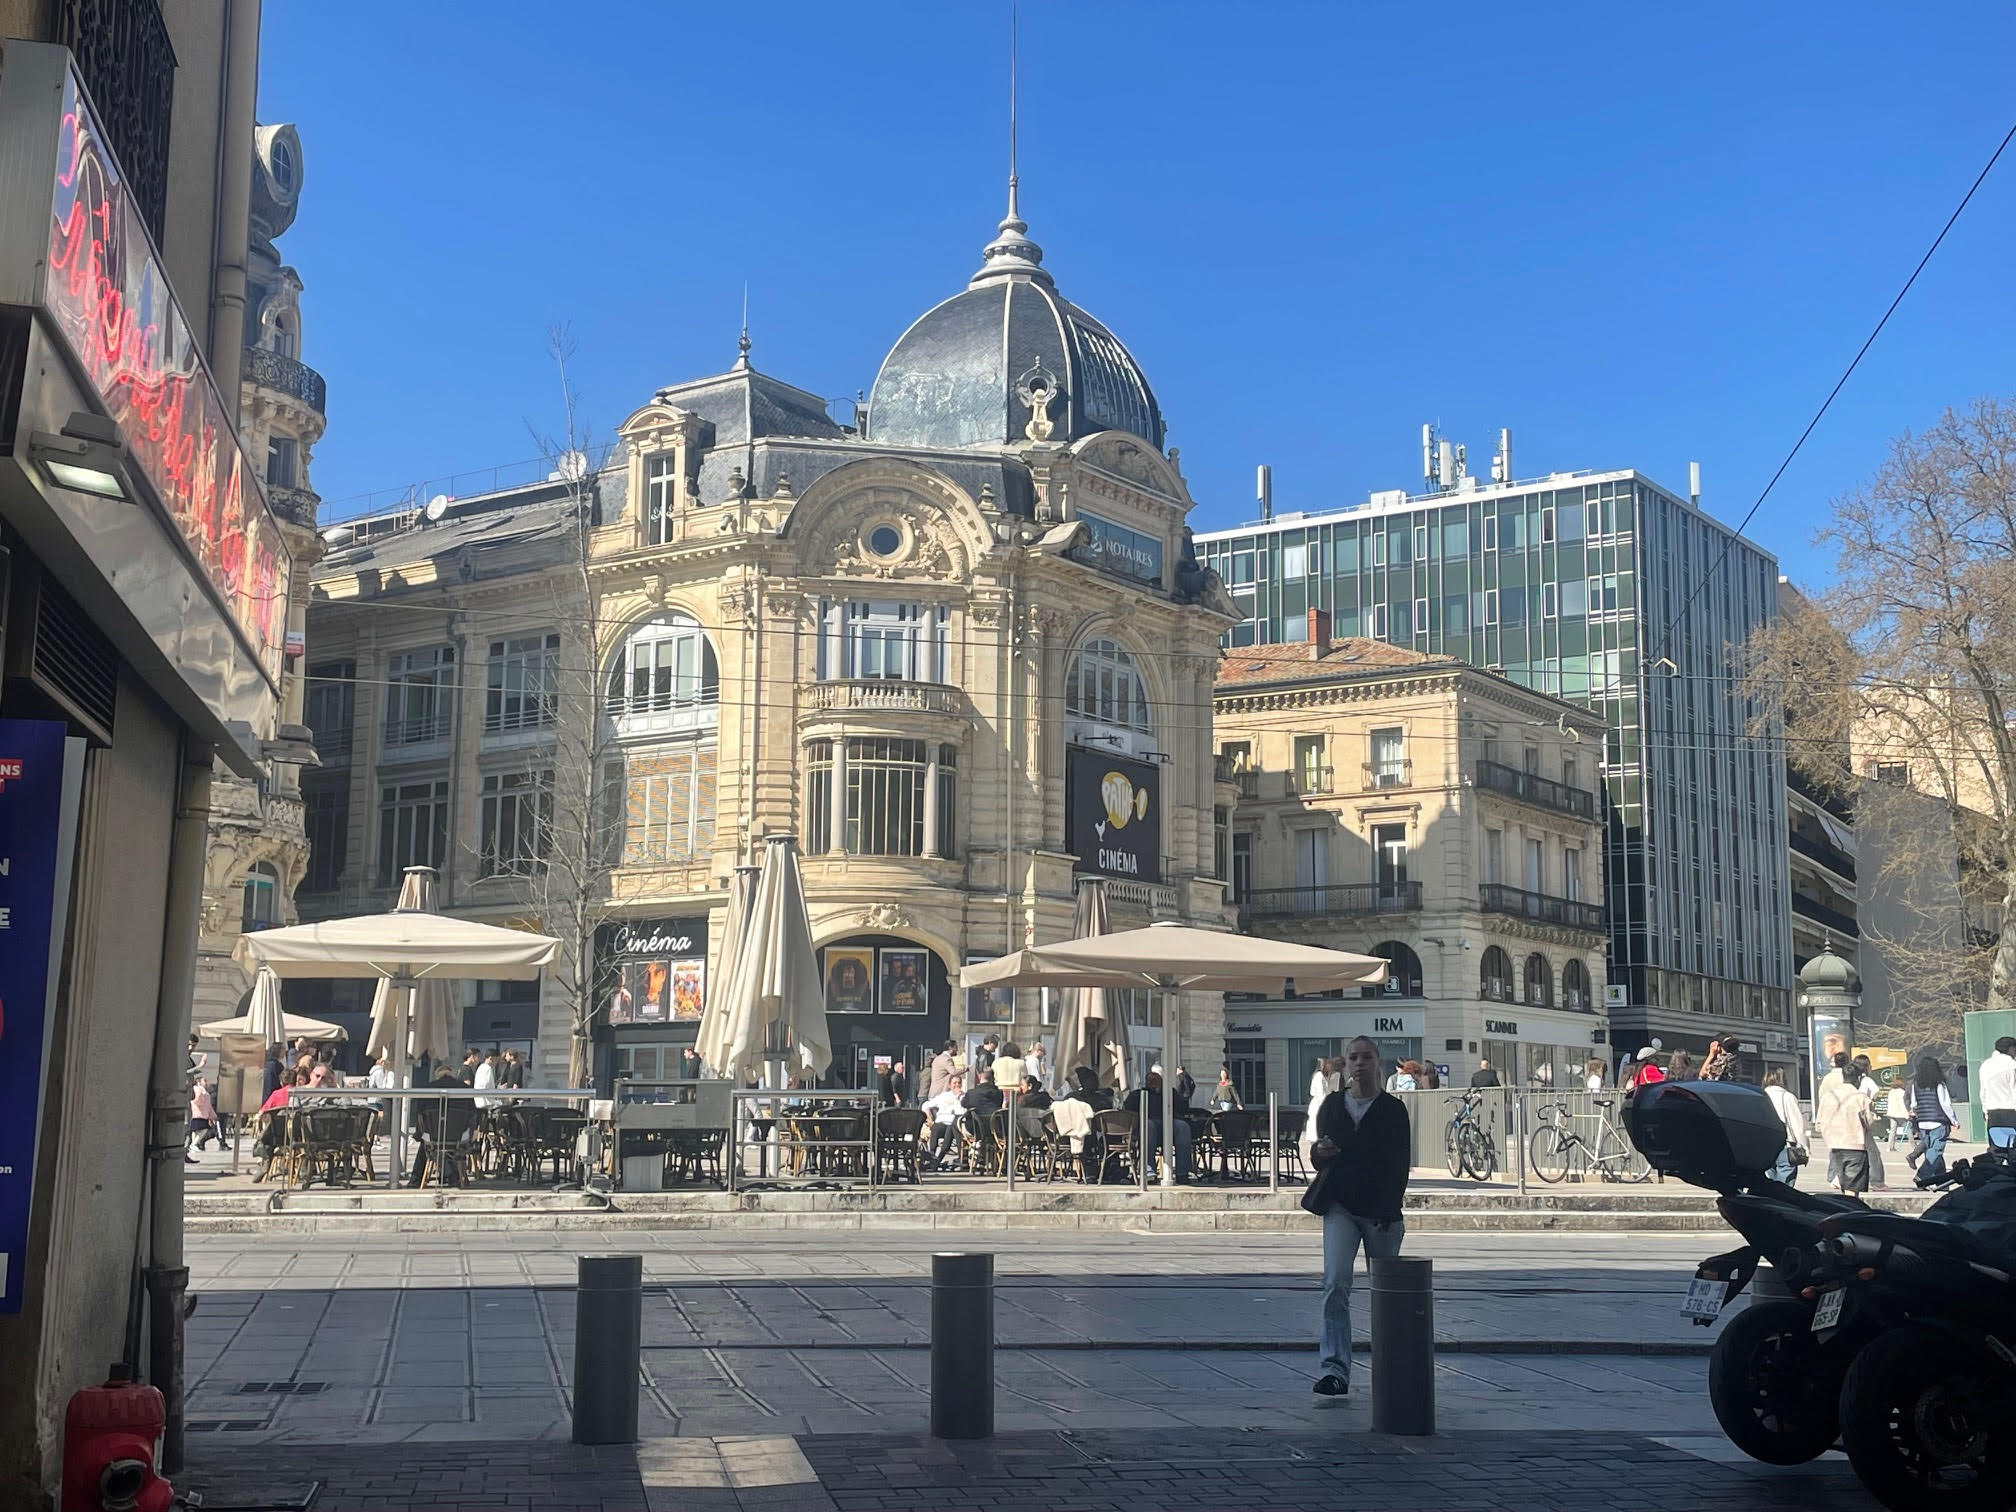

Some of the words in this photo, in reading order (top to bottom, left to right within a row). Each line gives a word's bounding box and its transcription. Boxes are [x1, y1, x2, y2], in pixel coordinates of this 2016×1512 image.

[1105, 539, 1153, 567] NOTAIRES
[1098, 846, 1138, 874] CINÉMA
[613, 926, 692, 954] Cinéma
[1374, 1017, 1404, 1031] IRM
[1485, 1019, 1518, 1035] SCANNER
